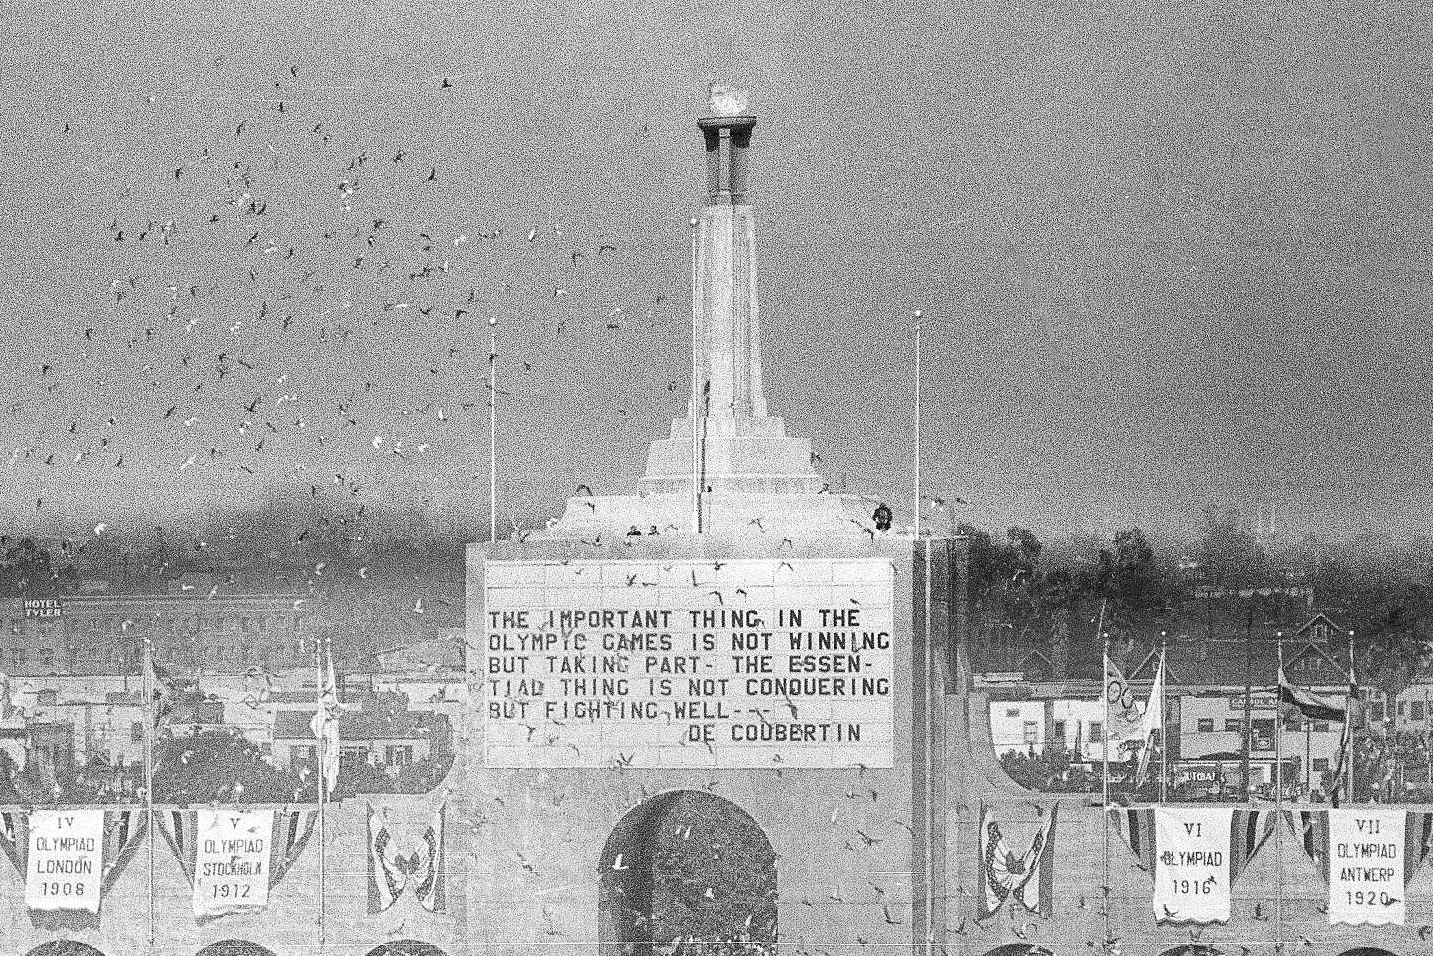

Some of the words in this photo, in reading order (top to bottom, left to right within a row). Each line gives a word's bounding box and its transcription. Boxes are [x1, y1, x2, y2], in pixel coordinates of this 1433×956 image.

[25, 599, 62, 608] HOTEL
[488, 611, 529, 629] THE
[549, 610, 673, 628] IMPORTANT
[689, 610, 759, 628] THING
[778, 609, 802, 627] IN
[818, 609, 860, 627] THE
[489, 633, 586, 651] OLYMPIC
[602, 633, 673, 651] GAMES
[692, 633, 715, 651] IS
[731, 632, 772, 650] NOT
[789, 631, 890, 650] WINNING
[489, 656, 529, 674] BUT
[546, 655, 629, 673] TAKING
[732, 655, 772, 673] THE
[789, 655, 872, 673] ESSEN-
[560, 678, 629, 696] THING
[648, 678, 672, 696] IS
[688, 678, 729, 696] NOT
[746, 677, 889, 696] CONQUERING
[489, 702, 529, 719] BUT
[546, 701, 659, 719] FIGHTING
[689, 724, 715, 742] DE
[731, 723, 861, 742] COUBERTIN
[58, 817, 74, 829] IV
[230, 817, 241, 829] V
[1184, 822, 1202, 837] VI
[1355, 819, 1380, 834] VII
[36, 837, 94, 852] OLYMPIAD
[204, 839, 263, 854] OLYMPIAD
[1337, 843, 1397, 858] OLYMPIAD
[1164, 851, 1223, 866] OLYMPIAD
[37, 859, 92, 874] LONDON
[203, 861, 262, 876] STOCKHOLM
[1340, 867, 1395, 881] ANTWERP
[42, 882, 85, 896] 1908
[213, 884, 250, 898] 1912
[1173, 879, 1211, 894] 1916
[1346, 891, 1389, 905] 1920
